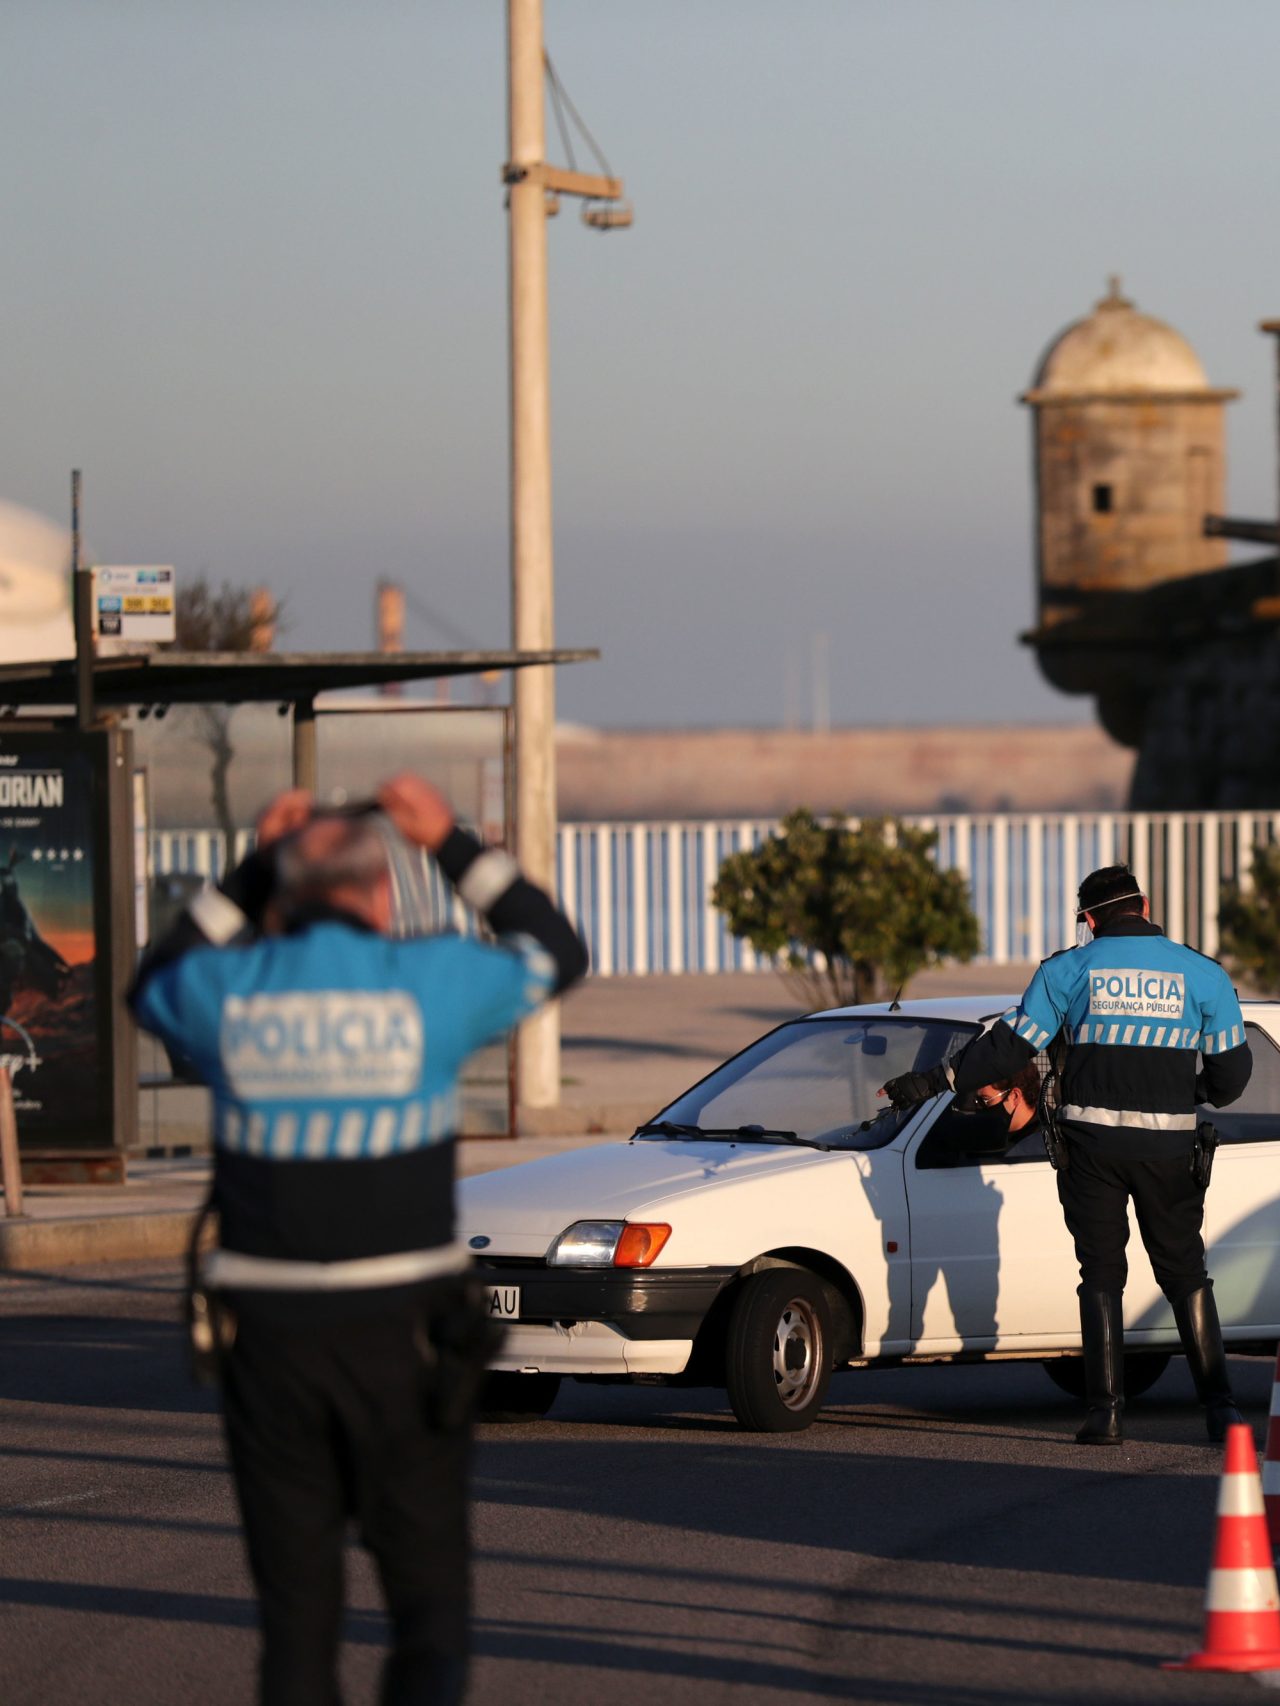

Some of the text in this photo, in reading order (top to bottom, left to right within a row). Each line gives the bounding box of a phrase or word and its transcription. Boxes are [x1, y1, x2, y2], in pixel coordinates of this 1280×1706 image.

[1092, 972, 1181, 1001] POLÍCIA
[1092, 1000, 1181, 1013] SEGURANÇA PÚBLICA
[490, 1289, 516, 1314] AU
